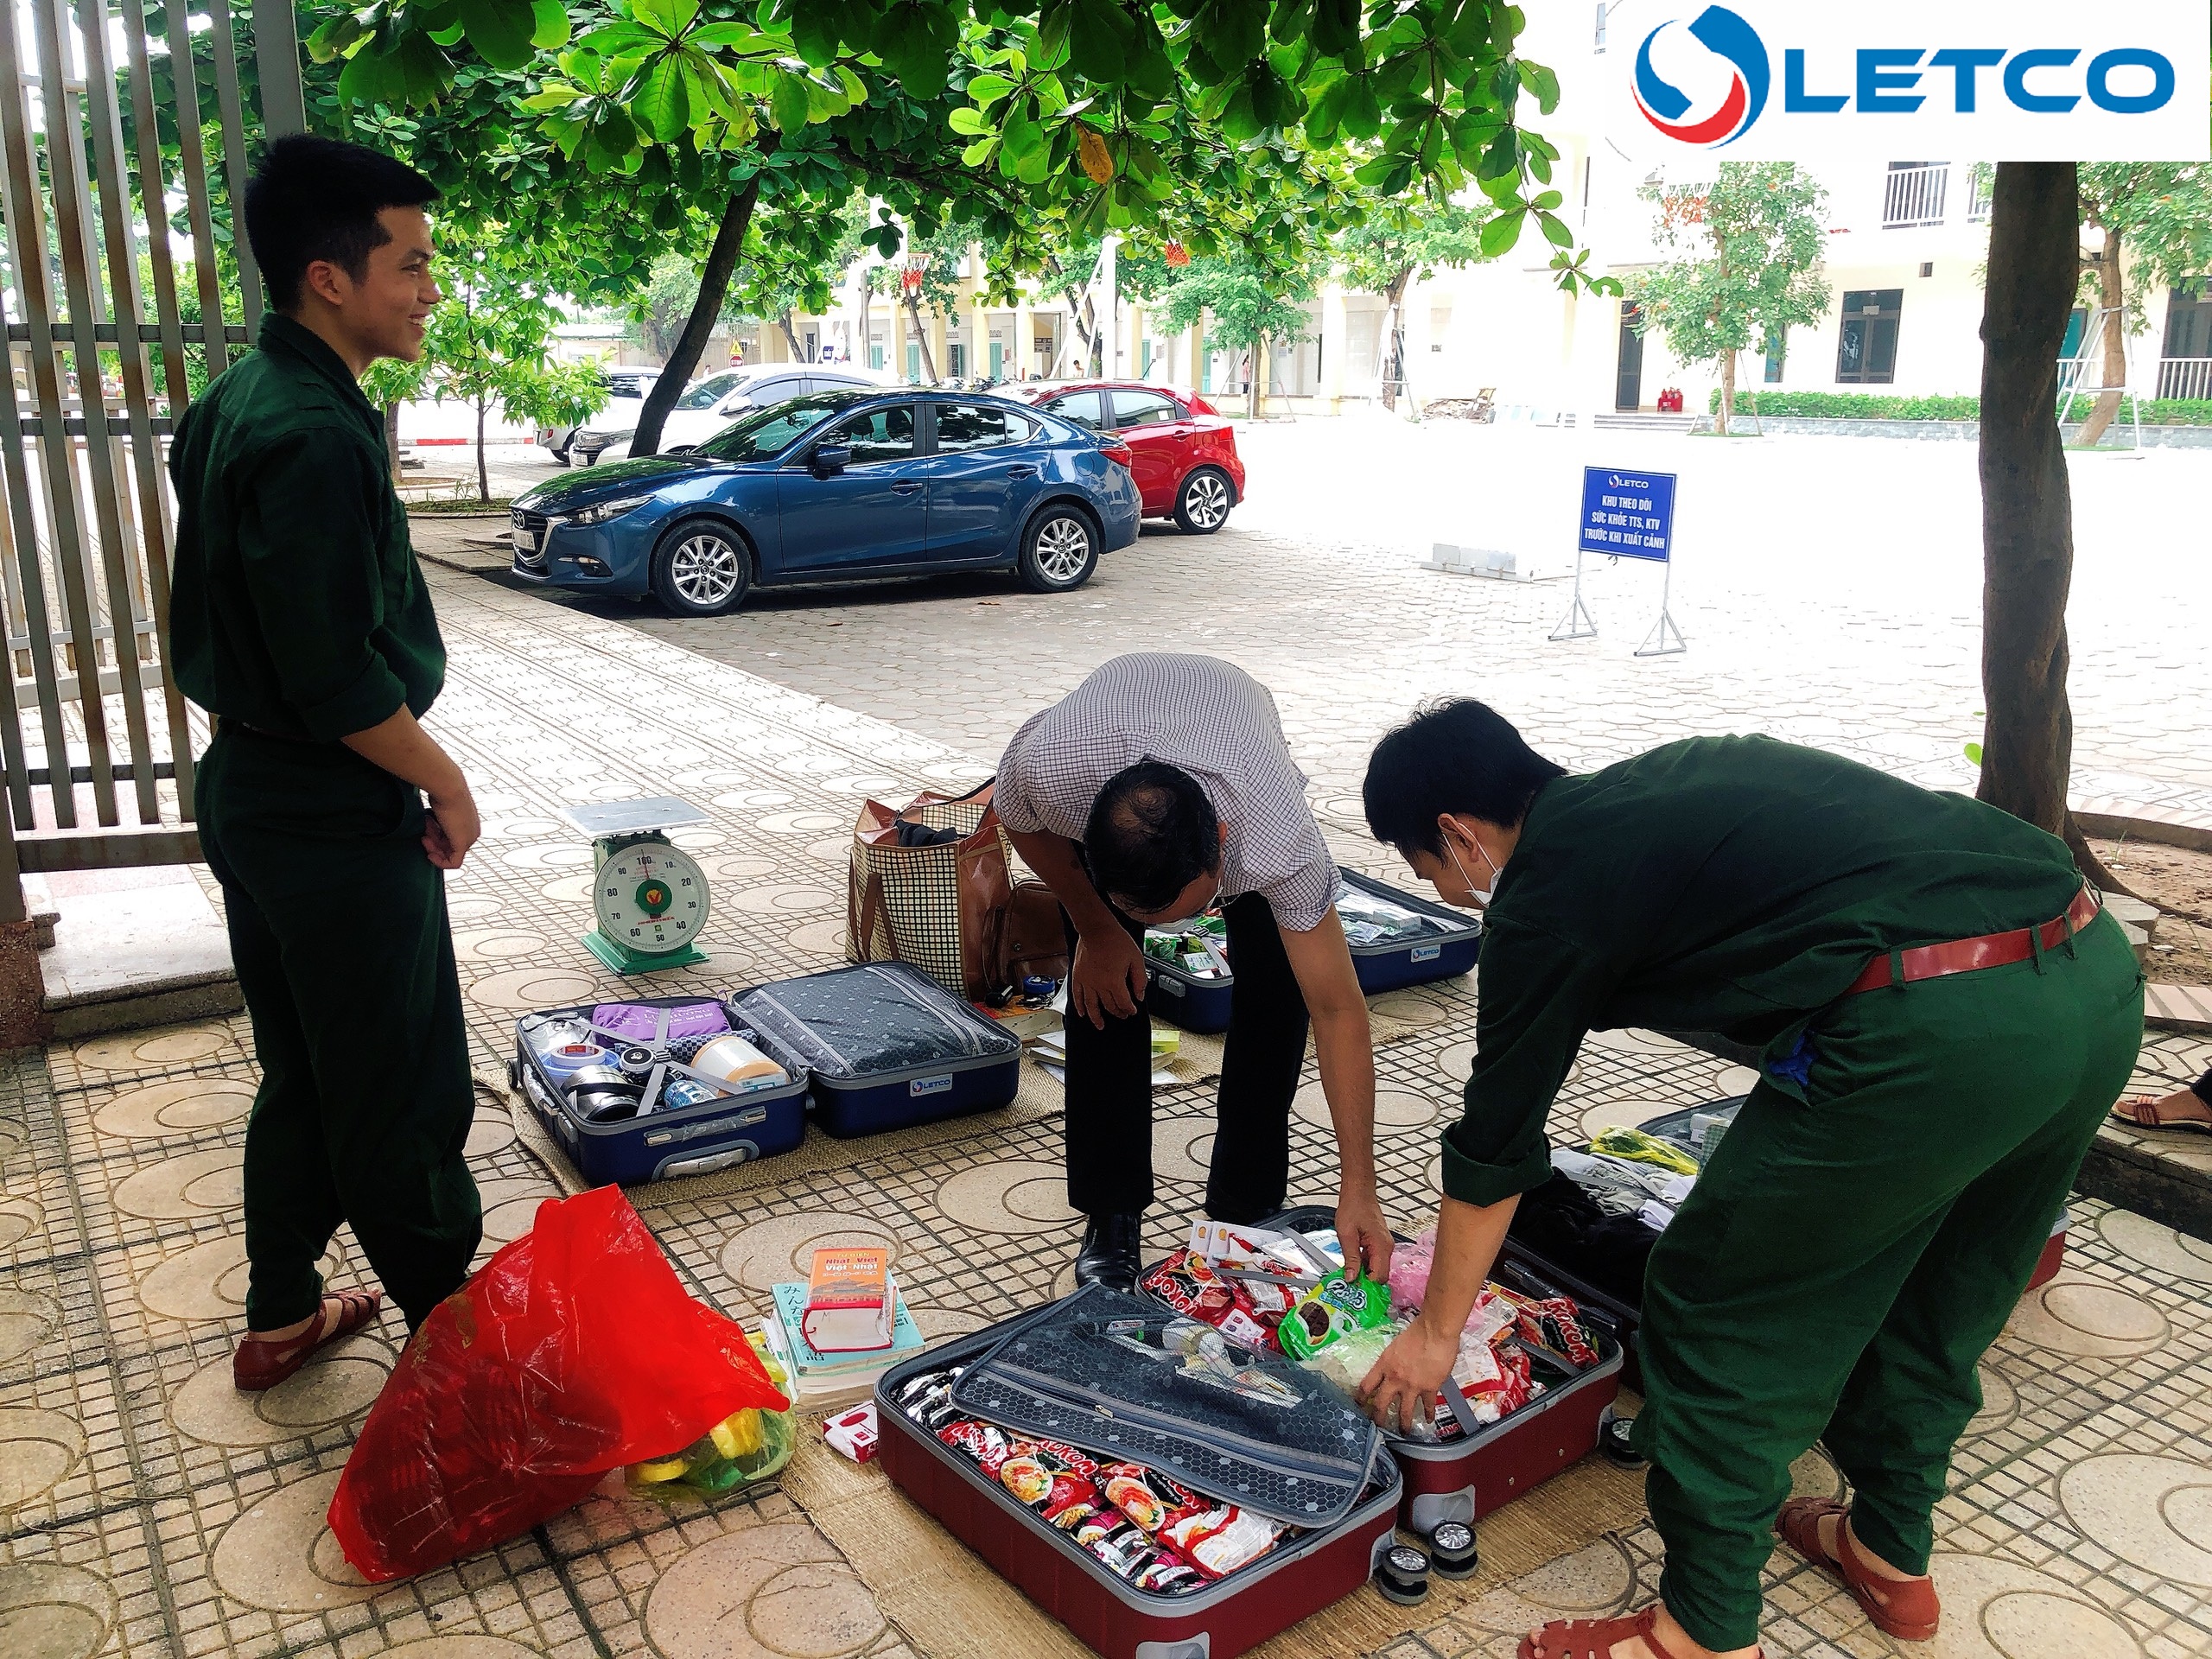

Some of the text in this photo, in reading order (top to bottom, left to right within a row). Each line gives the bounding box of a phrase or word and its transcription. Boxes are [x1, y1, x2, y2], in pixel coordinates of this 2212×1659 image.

[1619, 479, 1649, 489] LETCO
[1601, 494, 1653, 512] KHU THEO DÕI
[1591, 510, 1661, 531] SỨC KHỎE TTS, KTV
[1584, 527, 1666, 549] TRƯỚC KHI XUẤT CẢNH
[636, 855, 652, 866] 100
[681, 877, 691, 887] 20
[607, 887, 618, 897] 80
[676, 920, 687, 930] 40
[629, 927, 641, 938] 60
[1420, 948, 1440, 957] LETCO
[923, 1079, 951, 1089] LETCO
